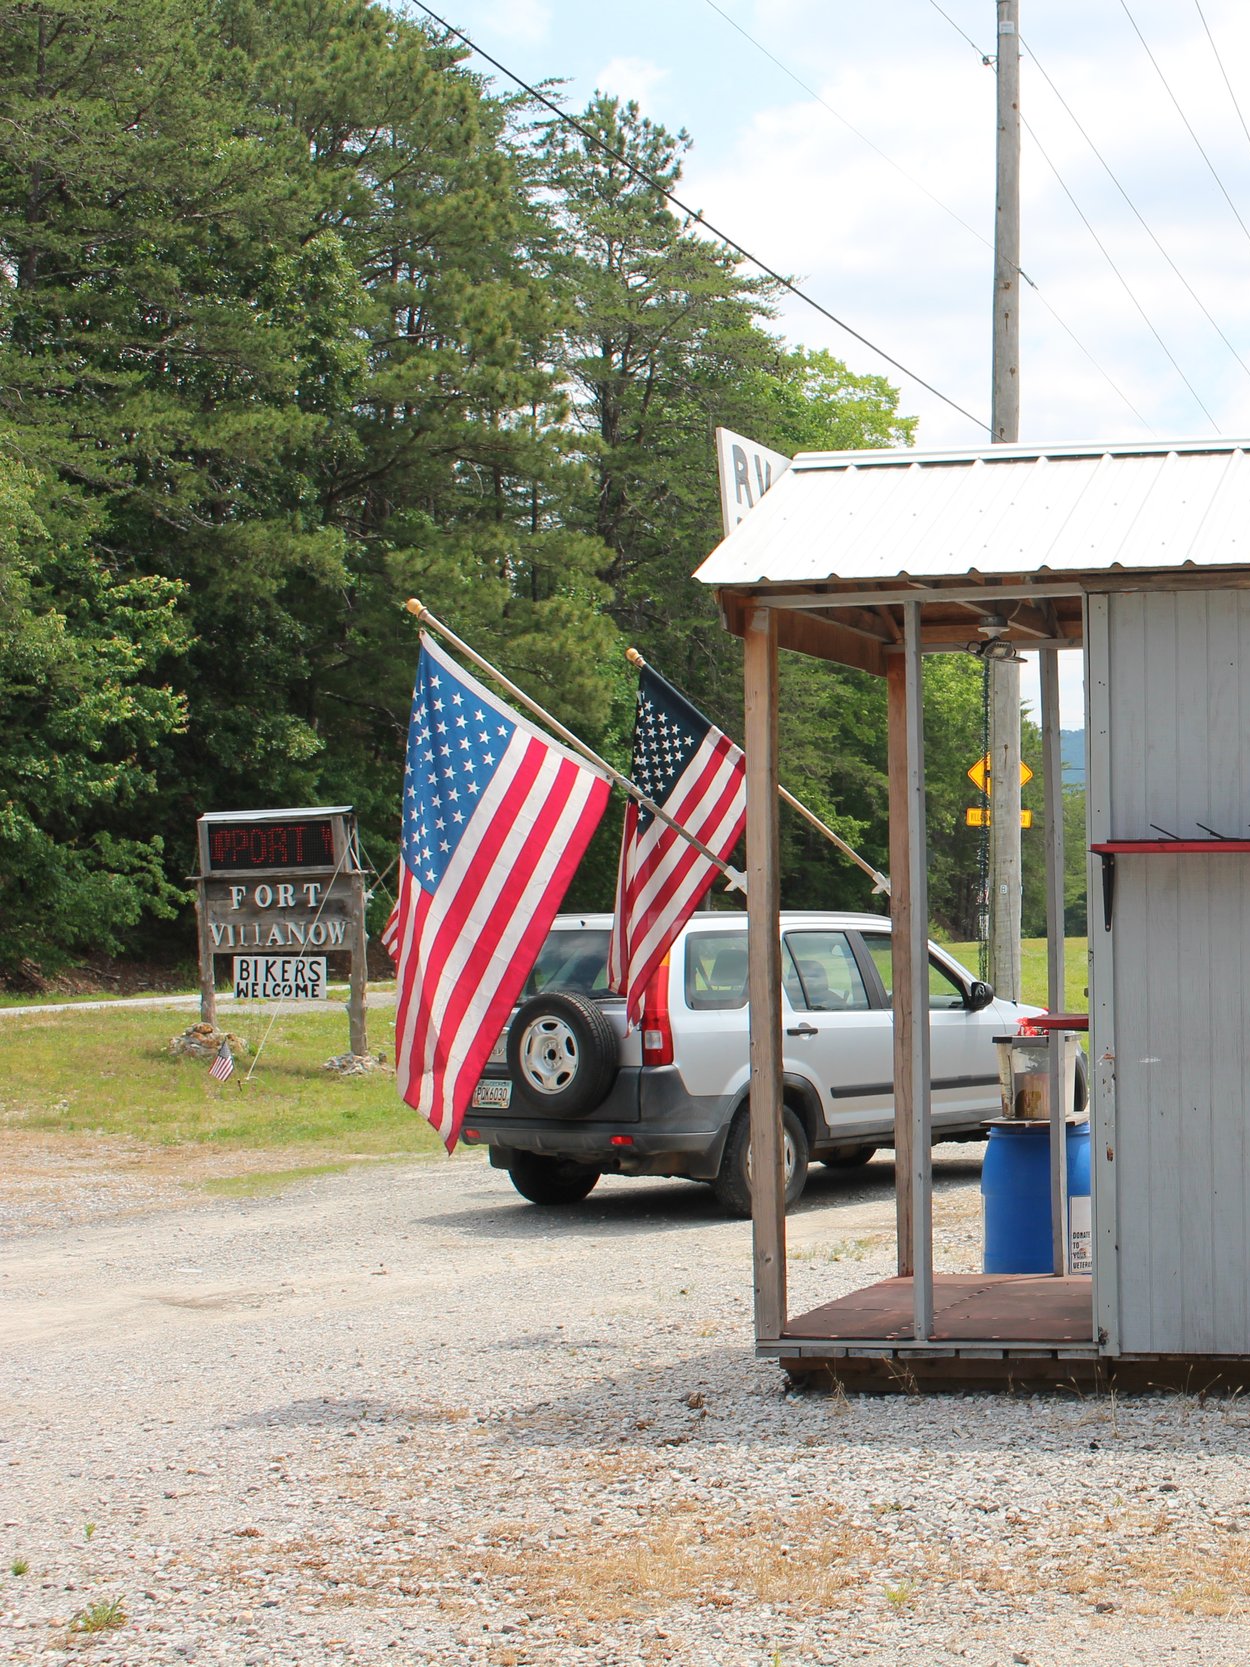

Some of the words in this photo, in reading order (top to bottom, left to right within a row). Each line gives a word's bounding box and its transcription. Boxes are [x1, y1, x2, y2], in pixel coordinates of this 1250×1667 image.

[229, 883, 321, 910] FORT
[208, 921, 347, 947] VILLANOW
[240, 959, 322, 983] BIKERS
[236, 982, 320, 998] WELCOME
[1072, 1241, 1080, 1250] TO
[1072, 1261, 1093, 1270] VETERA
